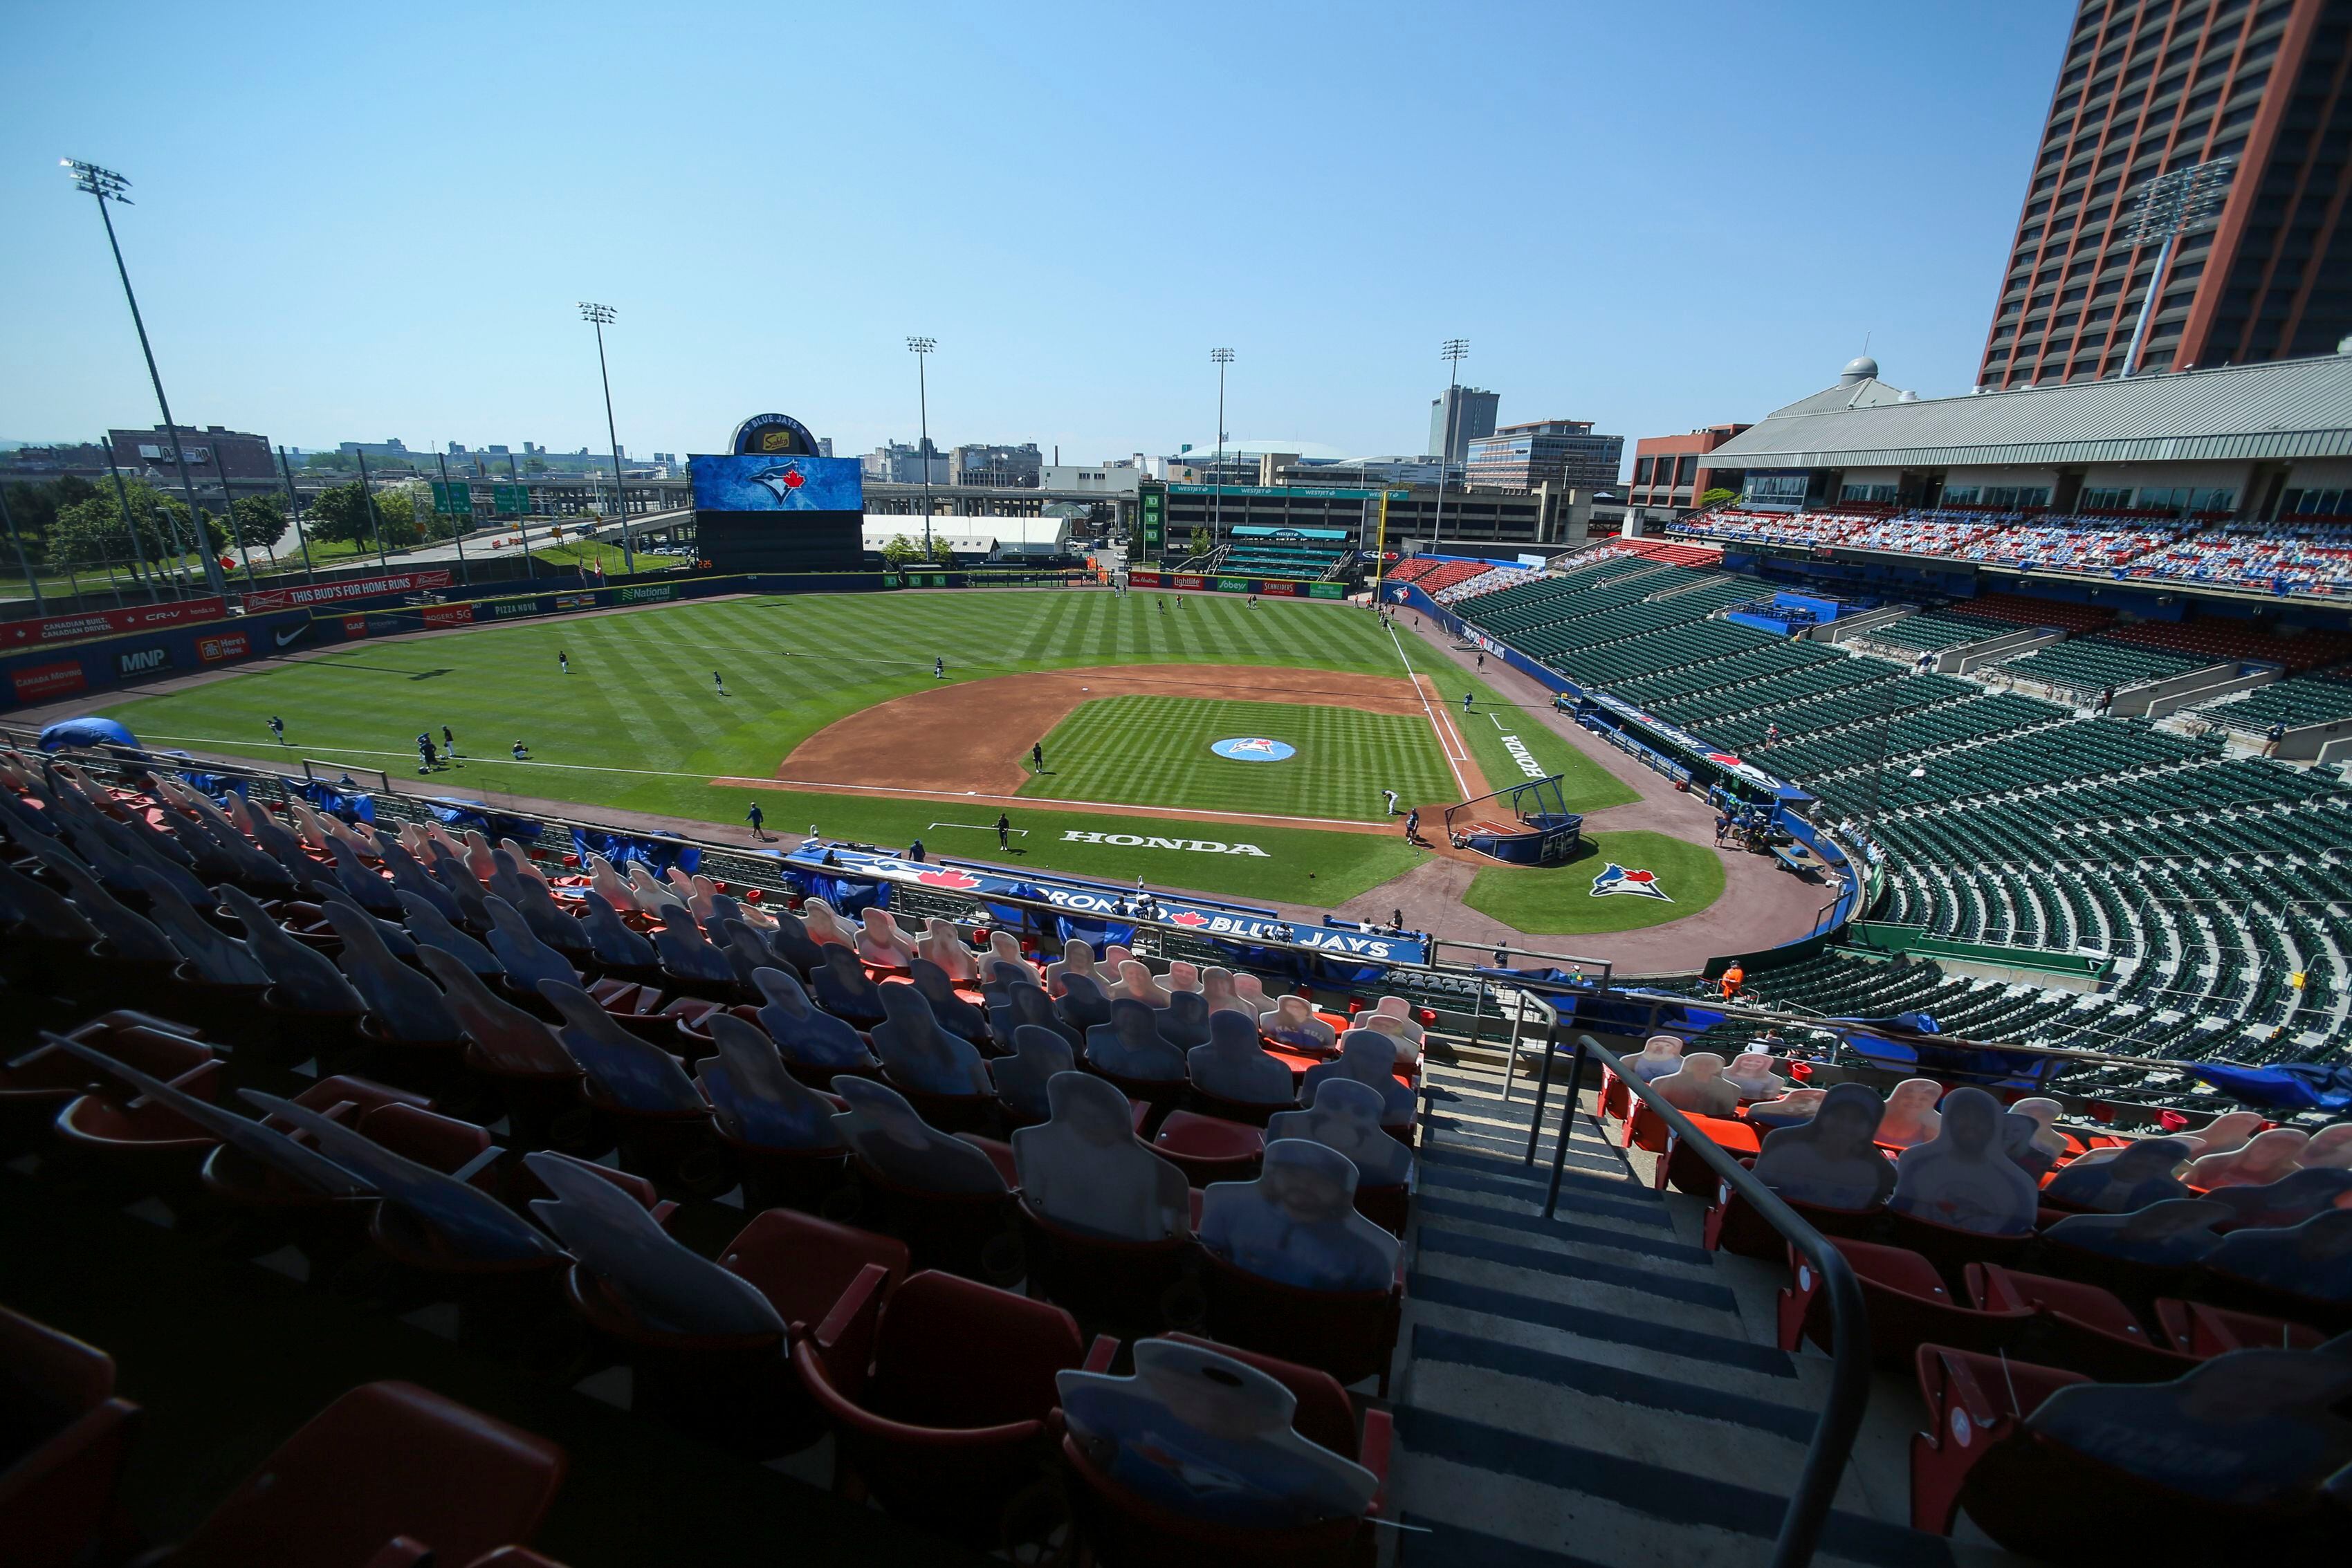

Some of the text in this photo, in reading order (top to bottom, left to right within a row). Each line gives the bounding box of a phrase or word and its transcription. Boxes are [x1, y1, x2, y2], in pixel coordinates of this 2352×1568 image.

[751, 415, 798, 429] BLUE JAYS
[1148, 497, 1158, 506] TD
[1148, 531, 1157, 539] TD
[291, 578, 411, 603] THIS BUD'S FOR HOME RUNS
[1220, 580, 1246, 589] Sobeys
[1264, 583, 1294, 592] SCHNEIDERS
[634, 586, 670, 598] National
[495, 602, 537, 615] PIZZA NOVA
[145, 611, 181, 621] CR-V
[426, 609, 471, 621] ROGERS 5G
[44, 618, 107, 631] CANADIAN BUILT.
[347, 622, 365, 630] GAF
[42, 624, 113, 638] CANADIAN DRIVEN.
[221, 637, 246, 647] Here's
[121, 649, 165, 672] MNP
[1500, 735, 1547, 778] HONDA
[1059, 830, 1271, 857] HONDA
[1209, 916, 1294, 939] BLU
[1299, 932, 1390, 957] JAYS
